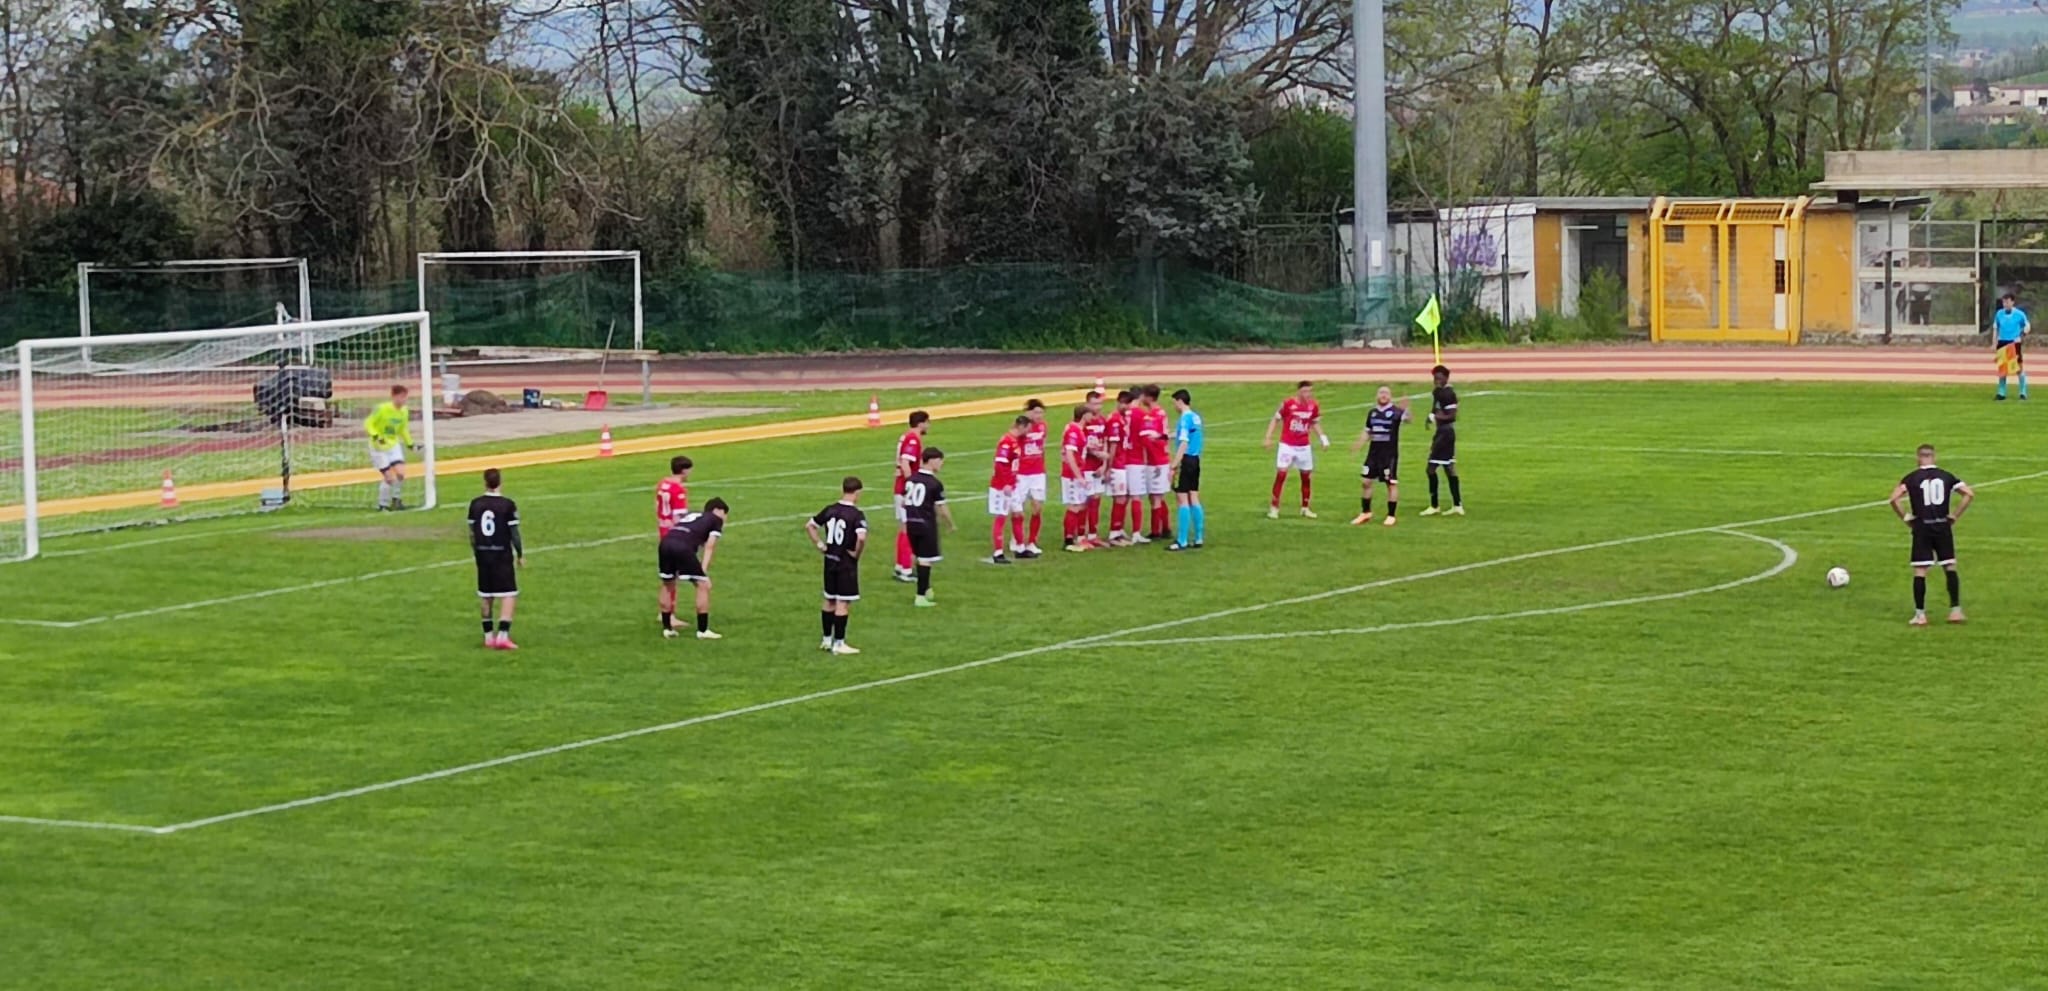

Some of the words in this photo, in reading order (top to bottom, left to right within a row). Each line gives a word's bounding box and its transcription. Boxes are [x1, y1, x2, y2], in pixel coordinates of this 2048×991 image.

[905, 481, 926, 507] 20
[1919, 478, 1945, 506] 10
[481, 510, 495, 537] 6
[826, 517, 847, 545] 16
